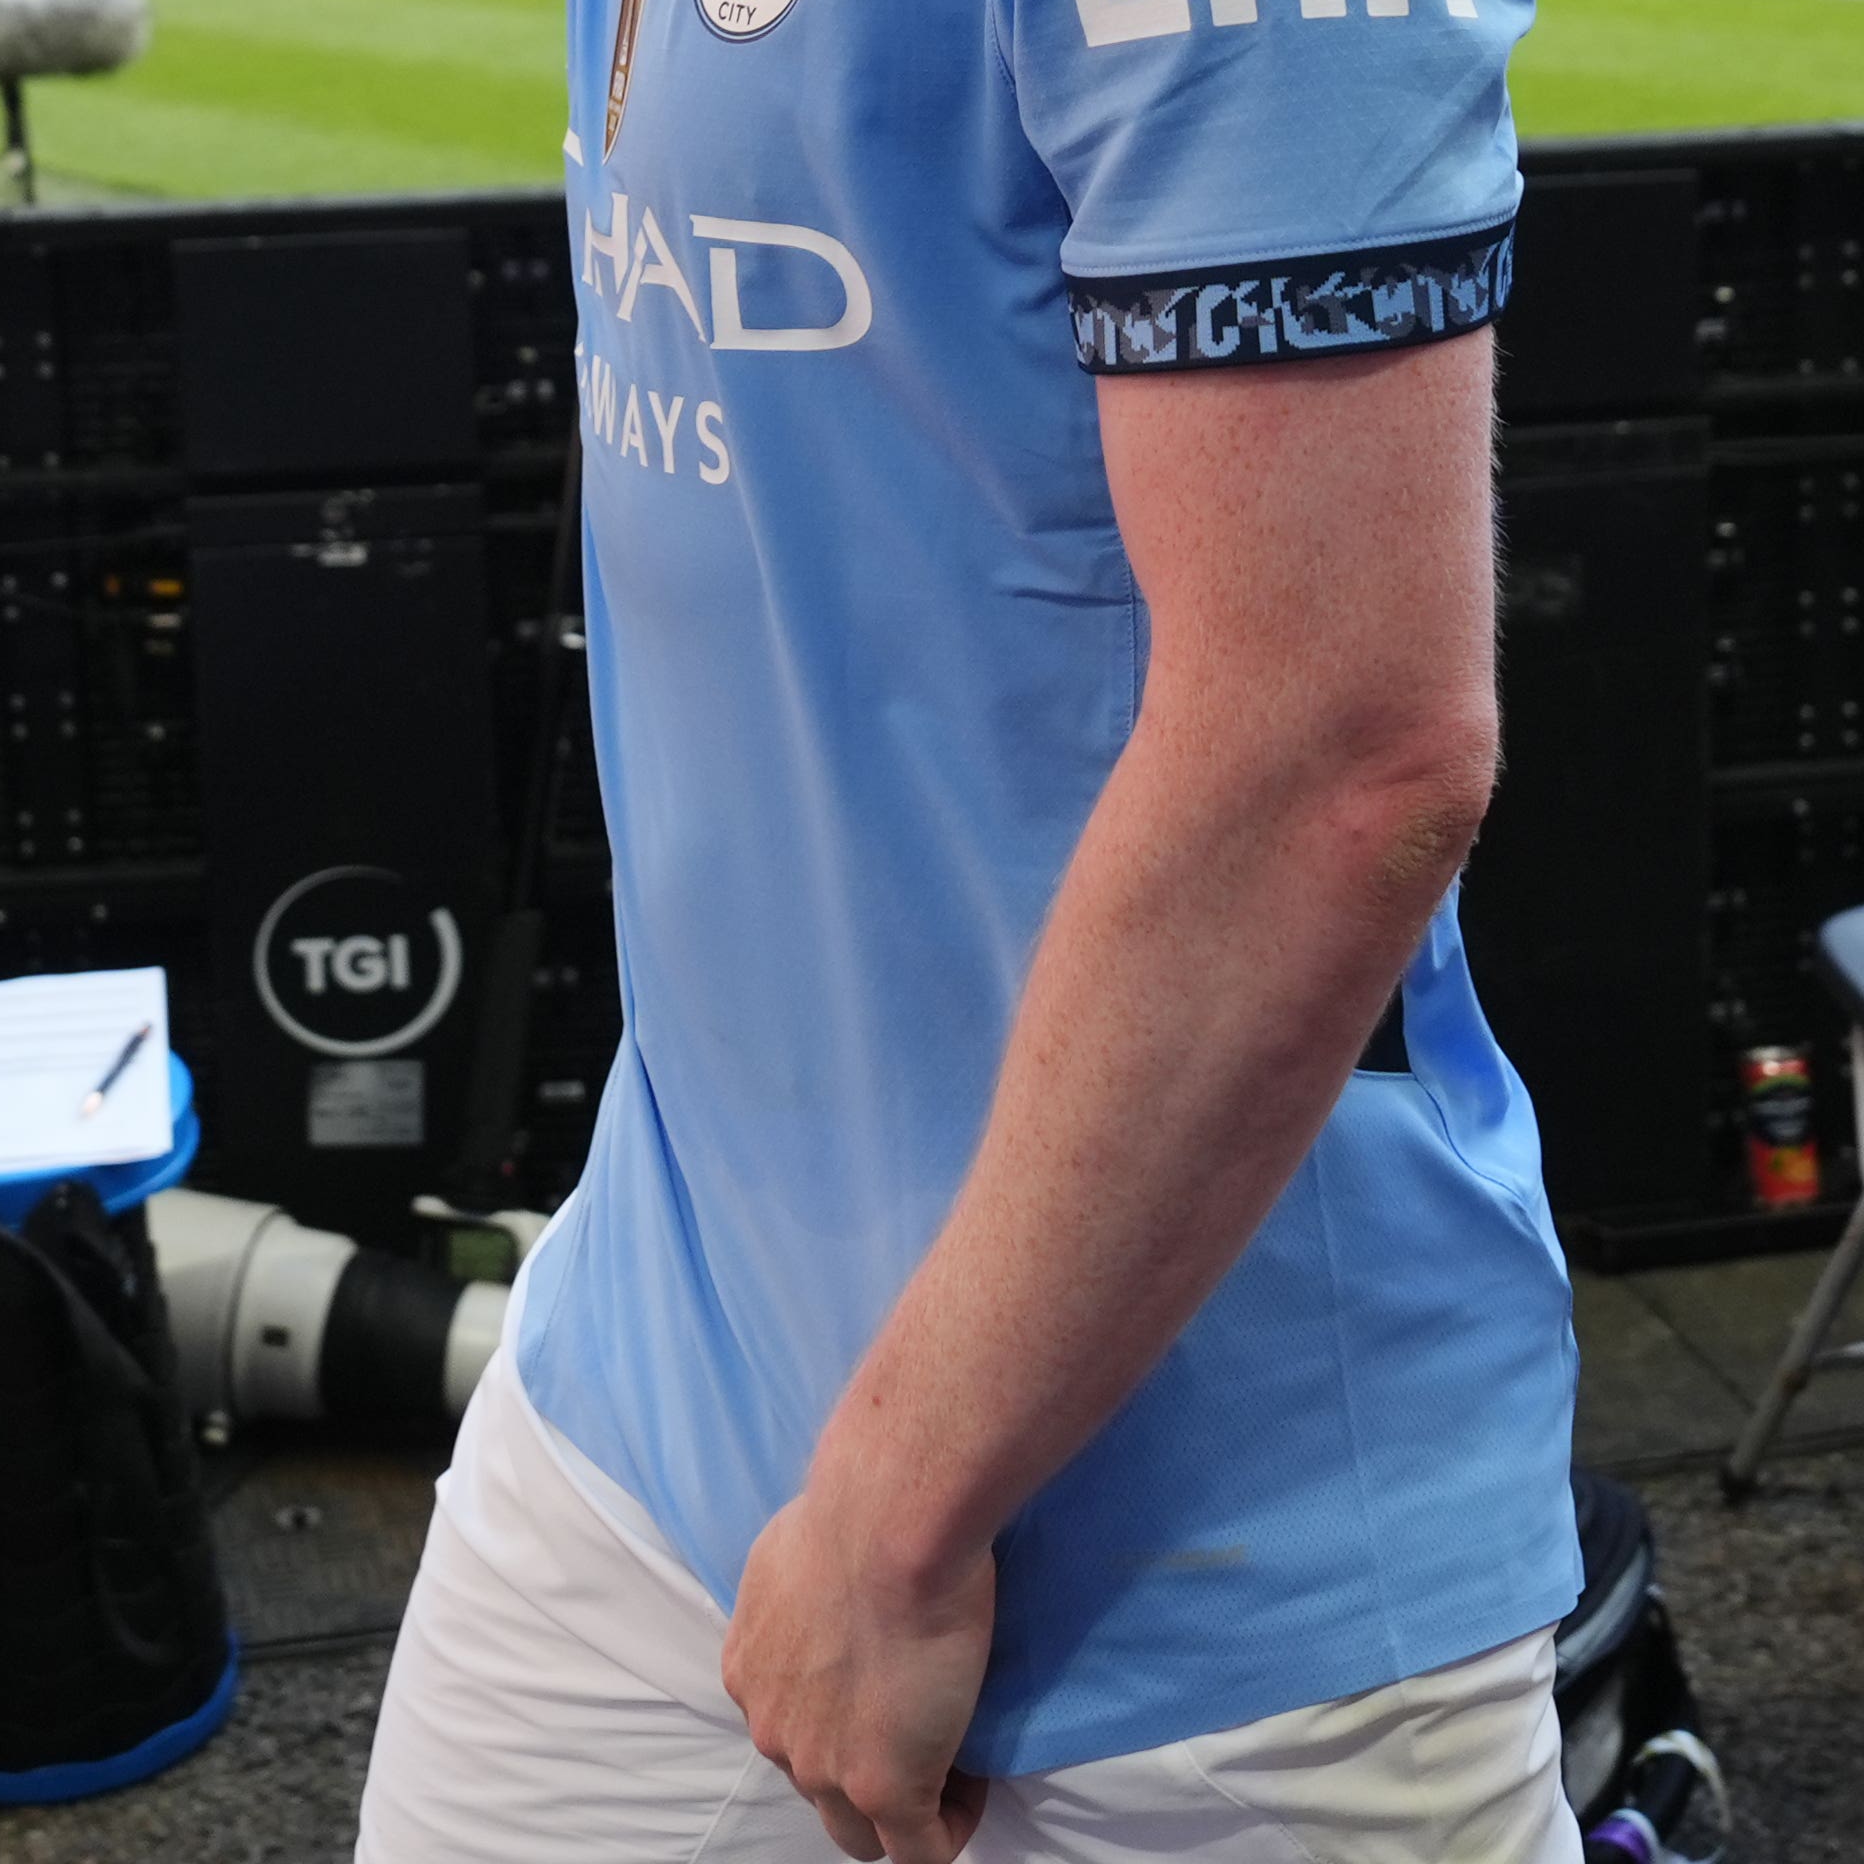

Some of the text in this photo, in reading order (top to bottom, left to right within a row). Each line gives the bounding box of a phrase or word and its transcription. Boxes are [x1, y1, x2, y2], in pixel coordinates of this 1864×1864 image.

[718, 1, 758, 26] CITY
[581, 192, 873, 352] HAD
[576, 342, 731, 485] WAYS
[289, 933, 412, 995] TGI
